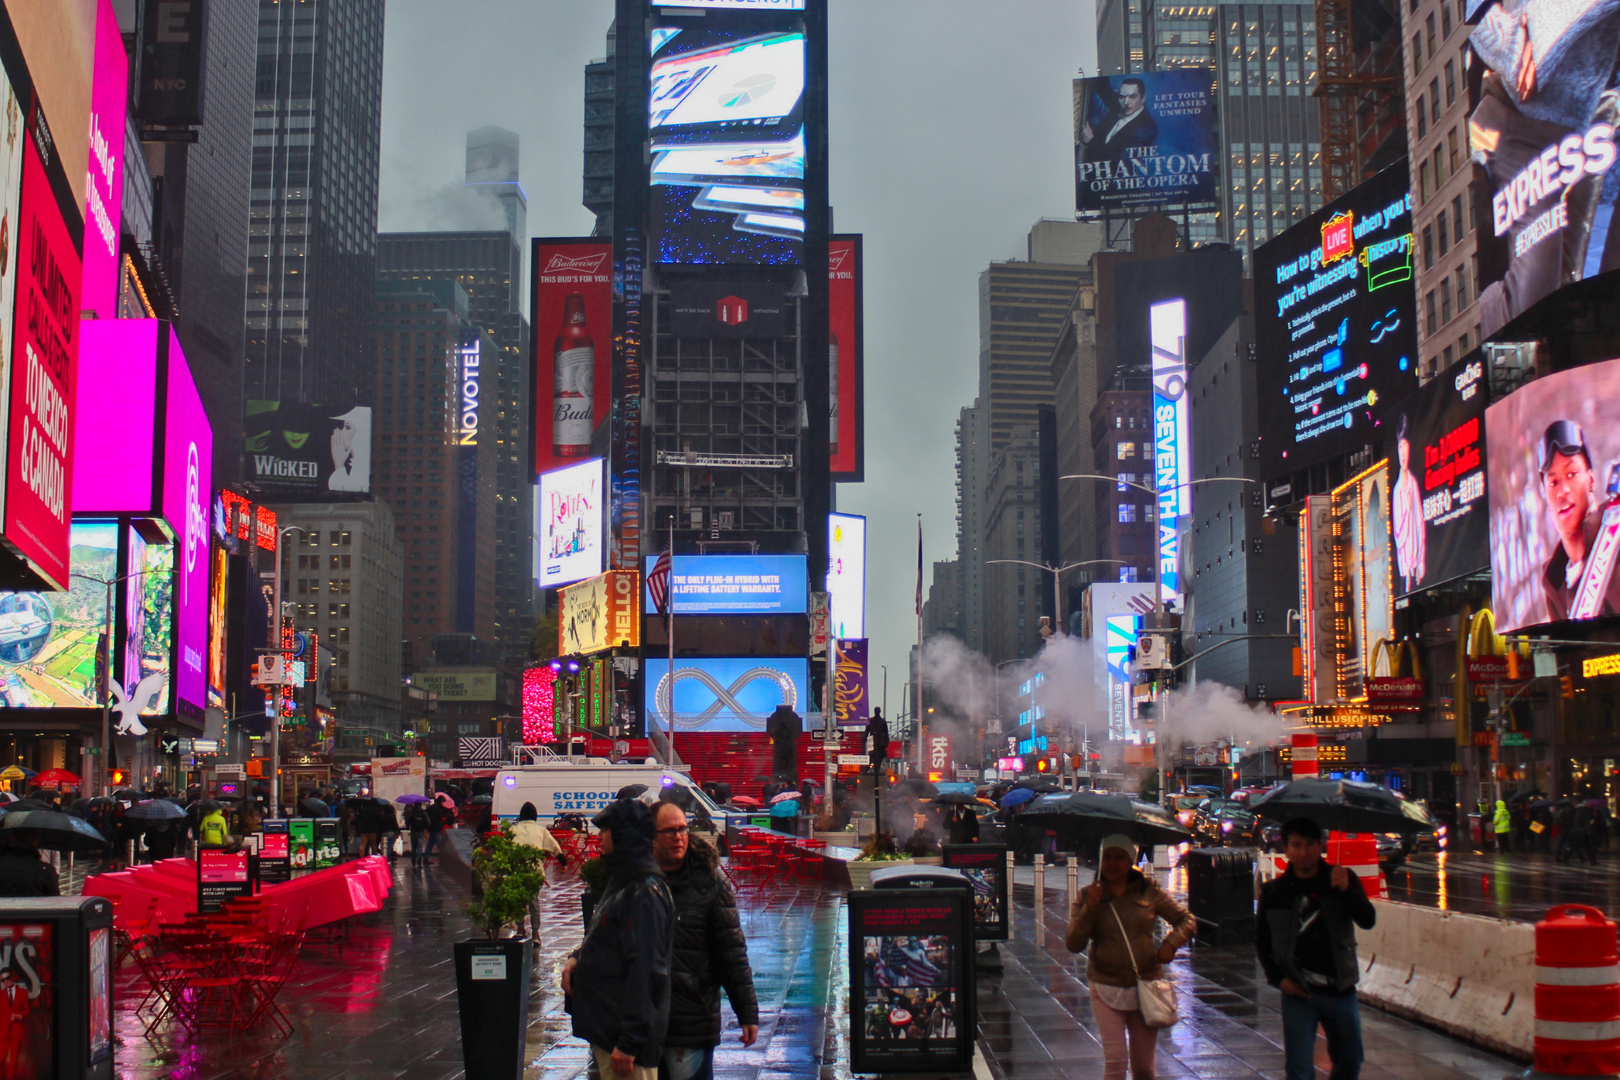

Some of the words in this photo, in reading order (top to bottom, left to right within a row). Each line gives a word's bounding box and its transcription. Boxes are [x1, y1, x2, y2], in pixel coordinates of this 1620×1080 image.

[154, 79, 186, 90] NYC
[1155, 93, 1173, 102] LET
[1178, 91, 1205, 100] YOUR
[1154, 99, 1207, 110] FANTASIES
[1160, 107, 1201, 117] UNWIND
[1126, 146, 1158, 158] THE
[1078, 153, 1210, 182] PHANTOM
[1493, 123, 1616, 237] EXPRESS
[1090, 180, 1114, 192] OF
[1114, 177, 1145, 190] THE
[1147, 174, 1199, 188] OPERA
[1277, 264, 1298, 284] How
[1298, 256, 1310, 272] to
[1310, 247, 1322, 271] go
[1326, 228, 1347, 250] LIVE
[1353, 212, 1383, 240] when
[1383, 199, 1404, 229] you
[549, 258, 600, 268] Budweiser
[32, 212, 73, 344] UNLIMITED
[1278, 285, 1307, 317] you're
[1307, 257, 1358, 296] witnessing
[26, 342, 38, 414] TO
[38, 364, 68, 458] MEXICO
[460, 339, 479, 446] NOVOTEL
[21, 415, 29, 483] &
[29, 427, 64, 524] CANADA
[1155, 405, 1177, 519] SEVENTH
[1160, 523, 1177, 575] AVE
[673, 576, 686, 584] THE
[688, 576, 704, 584] ONLY
[706, 575, 733, 584] PLUG-IN
[734, 575, 759, 584] HYBRID
[761, 575, 780, 584] WITH
[673, 585, 678, 593] A
[679, 585, 709, 593] LIFETIME
[711, 585, 740, 593] BATTERY
[741, 584, 781, 593] WARRANTY.
[1317, 508, 1335, 659] PALACE
[615, 574, 632, 646] HELLO!
[284, 627, 293, 718] HERSEYS
[1369, 683, 1422, 691] McDonald's
[1314, 714, 1393, 724] ILLUSIONISTS
[287, 755, 323, 764] nuchas
[932, 736, 948, 768] tkts
[553, 791, 617, 800] SCHOOL
